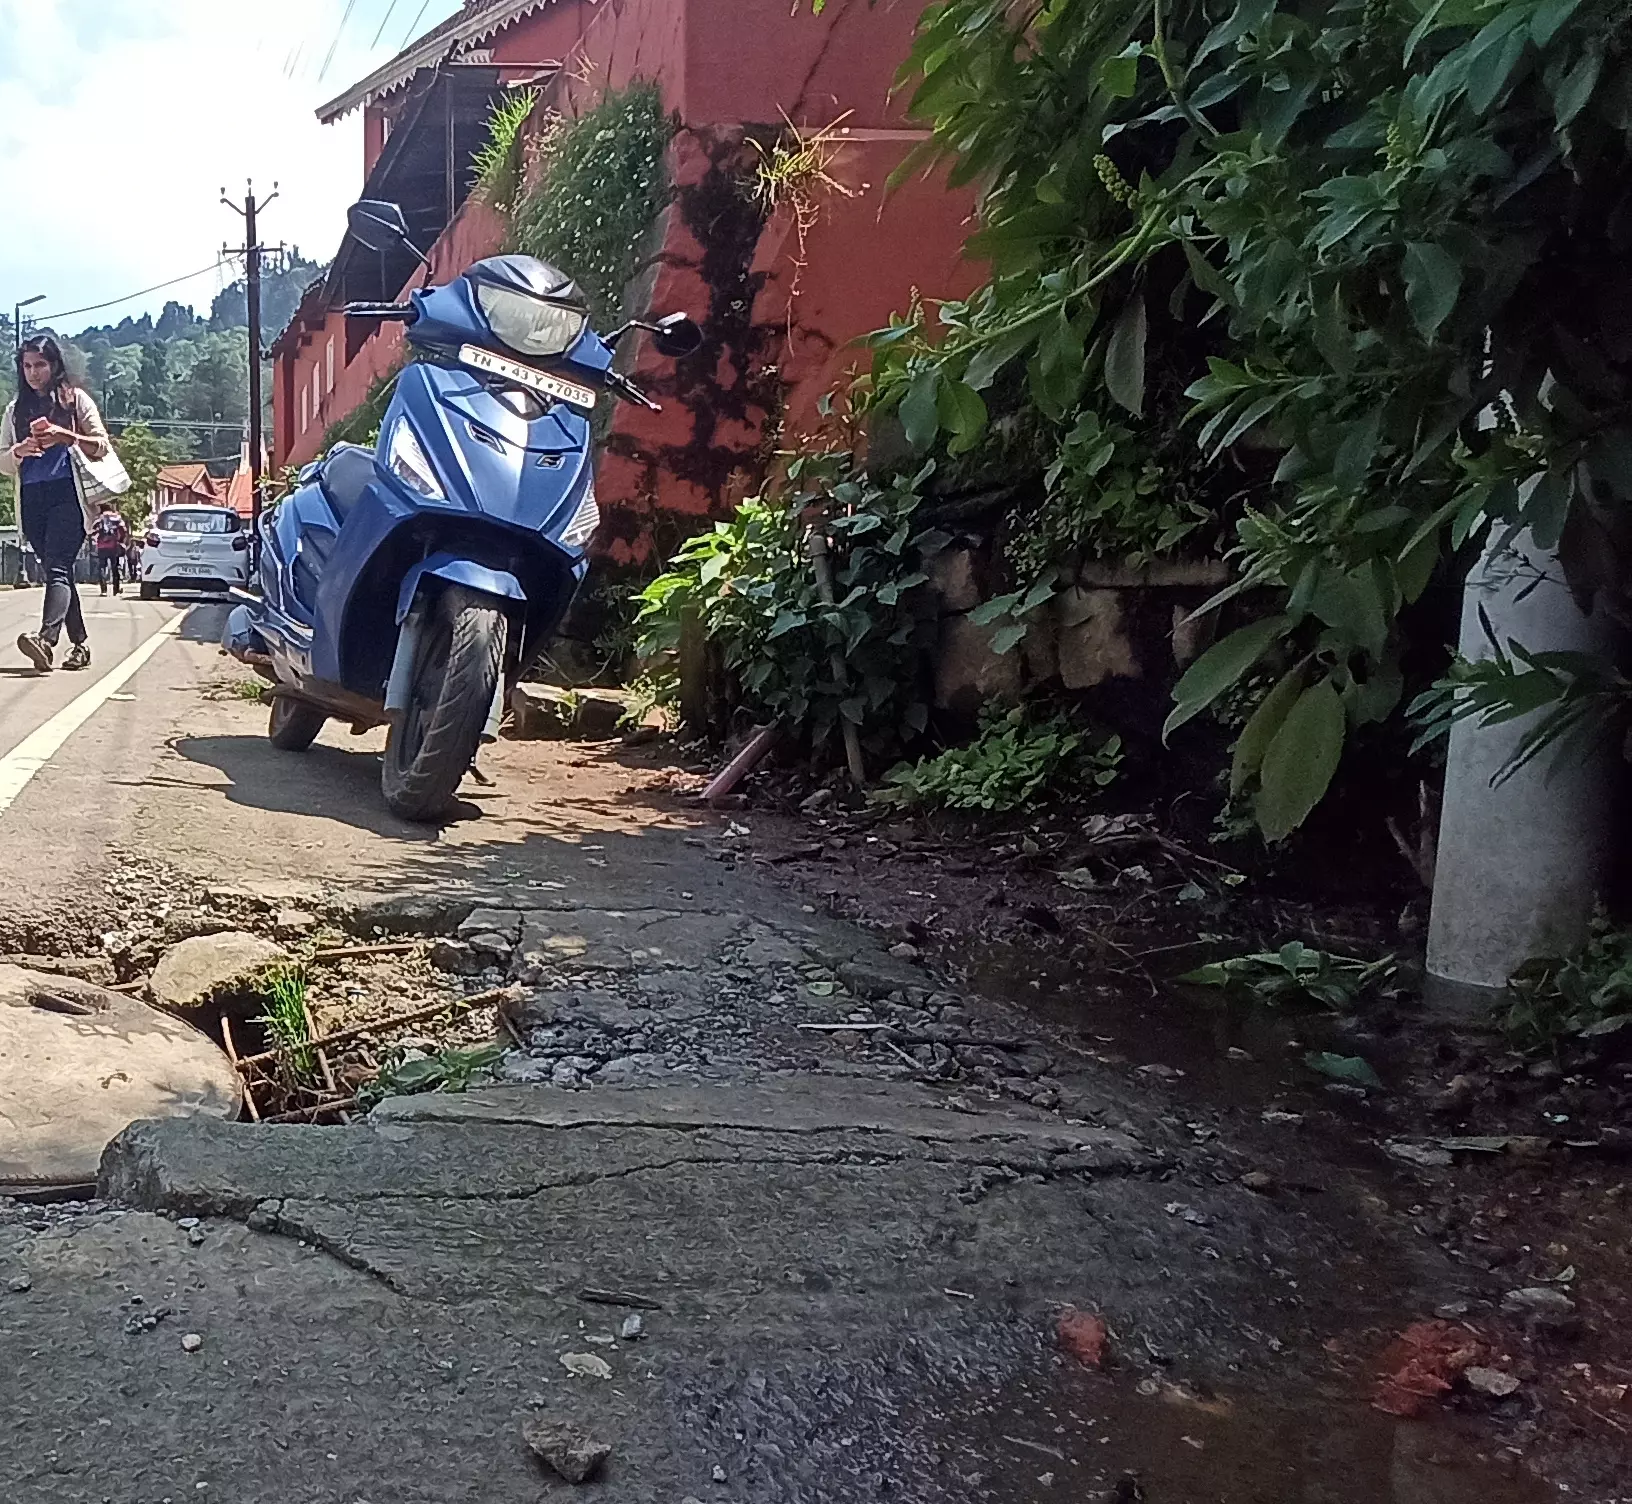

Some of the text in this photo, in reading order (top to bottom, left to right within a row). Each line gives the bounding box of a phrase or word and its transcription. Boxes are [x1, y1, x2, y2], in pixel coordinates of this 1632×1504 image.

[472, 352, 589, 404] TN 43 Y 7035
